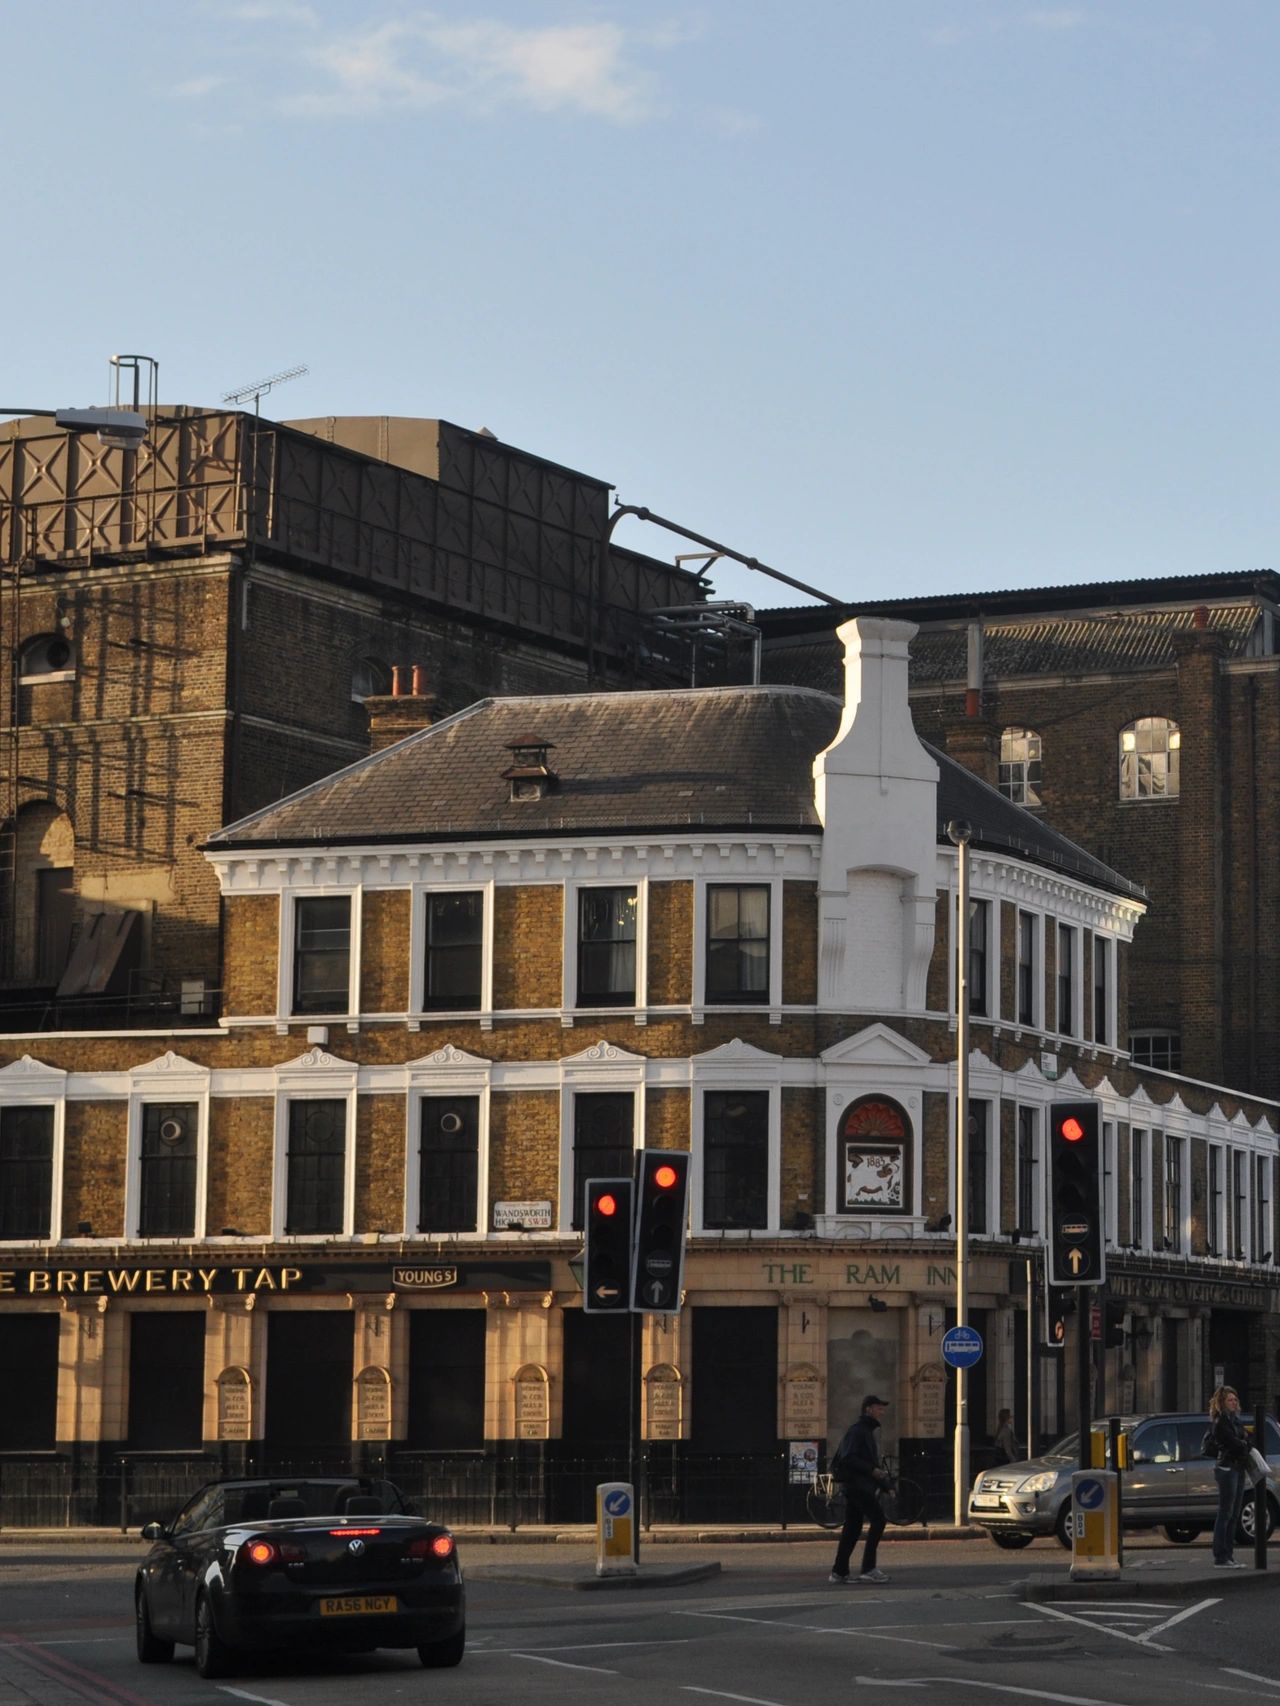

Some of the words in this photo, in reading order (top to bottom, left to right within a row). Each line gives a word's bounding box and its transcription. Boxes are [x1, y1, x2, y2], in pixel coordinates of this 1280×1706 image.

[495, 1209, 551, 1218] WANDSWORTH
[29, 1268, 217, 1294] BREWERY
[231, 1267, 302, 1291] TAP
[762, 1263, 814, 1285] THE
[846, 1264, 900, 1285] RAM
[326, 1599, 362, 1613] RA56
[365, 1597, 391, 1611] NGY
